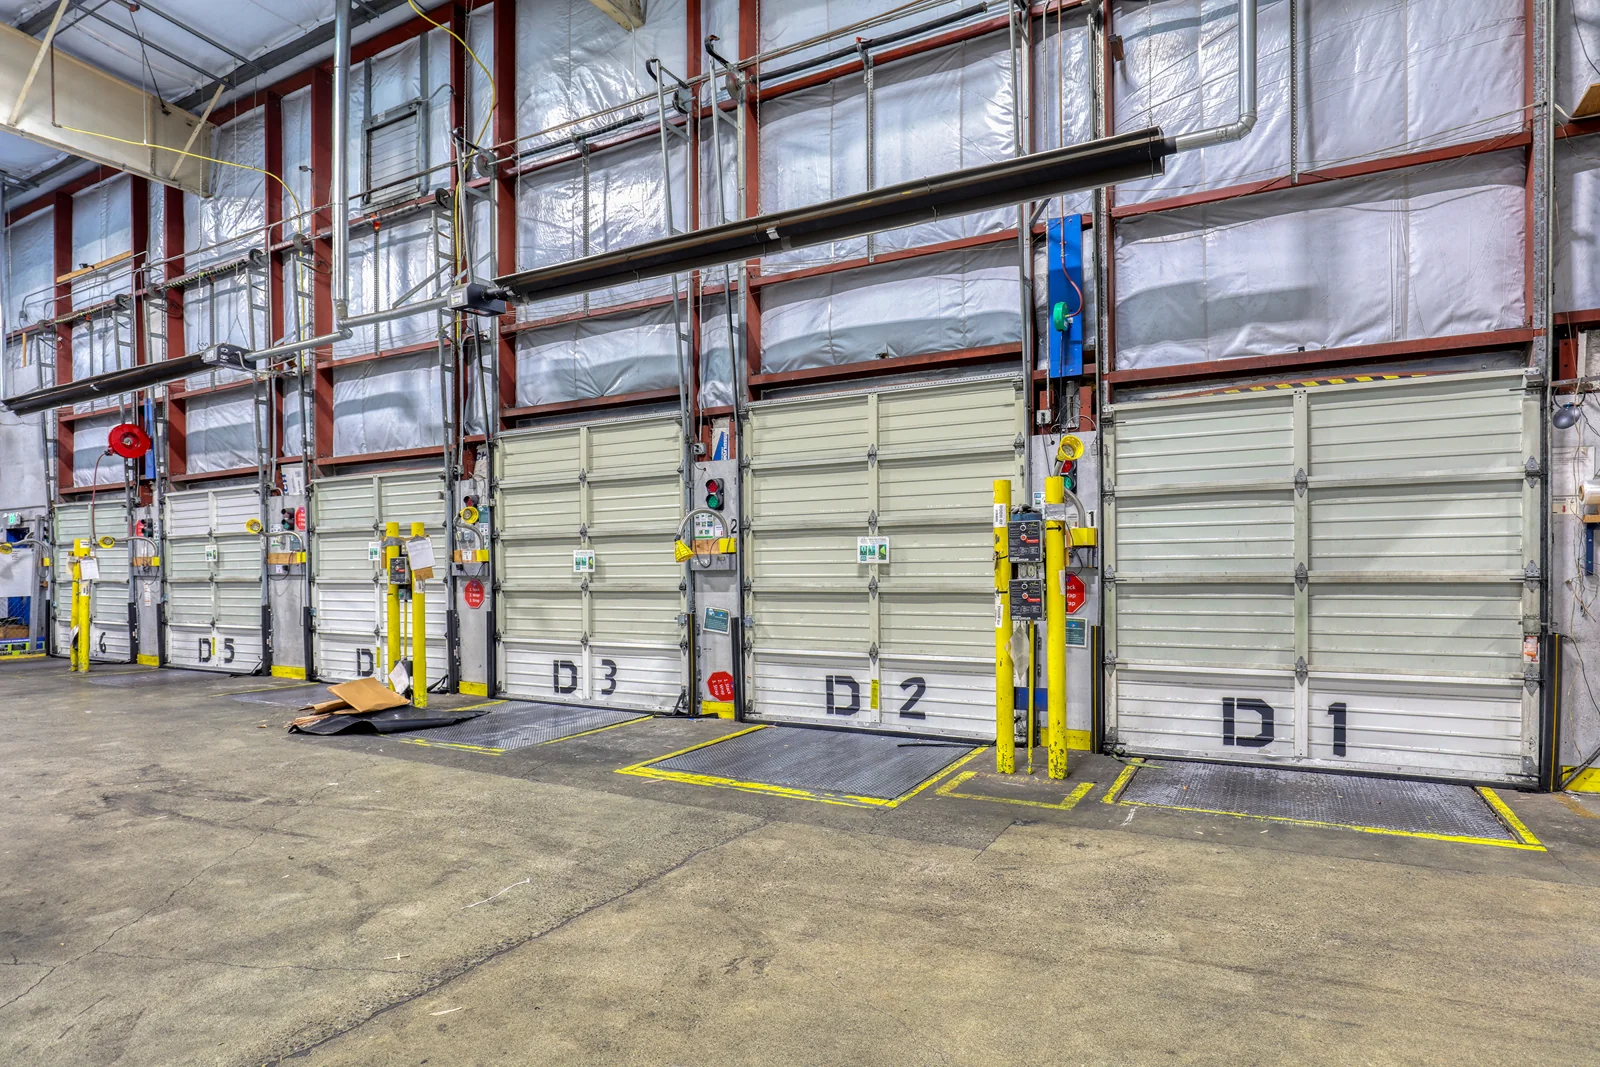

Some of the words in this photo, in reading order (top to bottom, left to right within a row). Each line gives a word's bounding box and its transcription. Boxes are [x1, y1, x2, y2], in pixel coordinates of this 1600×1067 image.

[731, 518, 737, 534] 2
[1088, 511, 1094, 527] 1
[99, 632, 107, 654] 6
[199, 638, 212, 663] D
[224, 638, 235, 664] 5
[356, 648, 374, 677] D
[553, 660, 578, 694] D
[601, 659, 617, 696] 3
[825, 675, 860, 716] D
[899, 676, 926, 720] 2
[1222, 697, 1274, 748] D
[1327, 702, 1346, 757] 1
